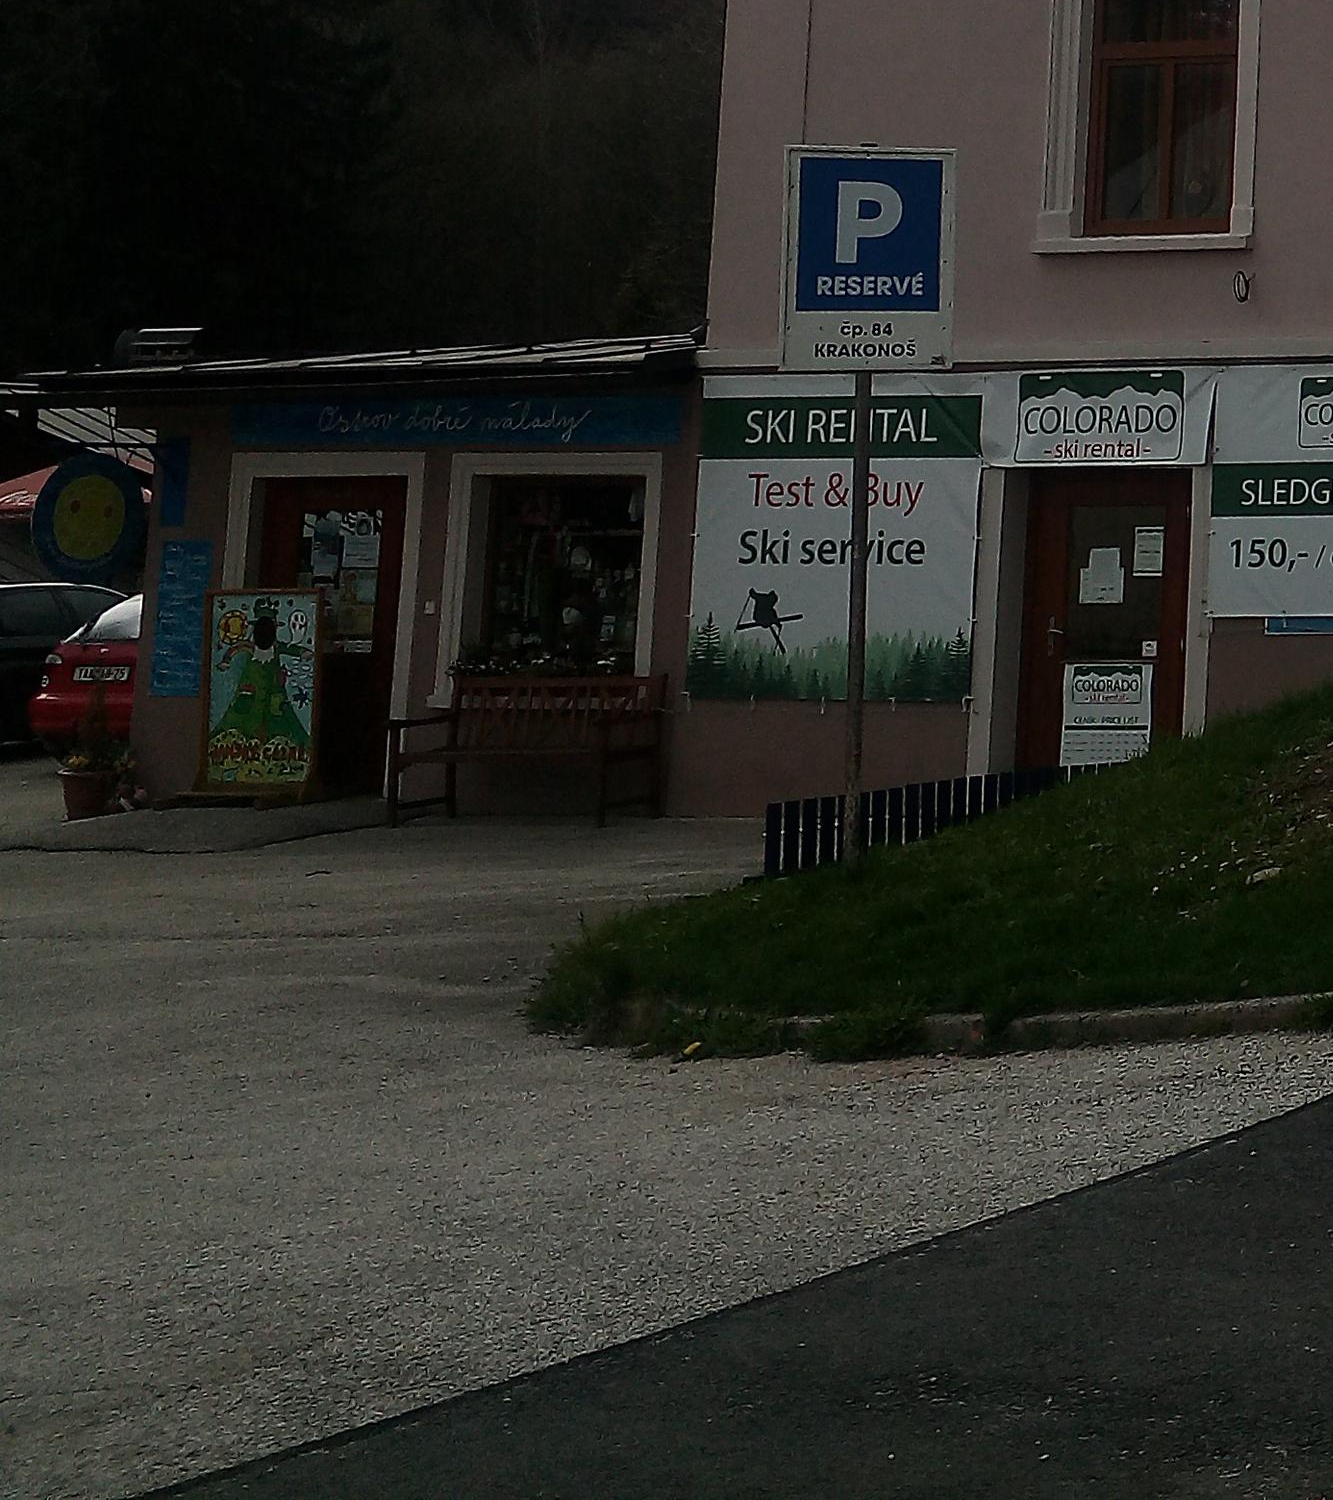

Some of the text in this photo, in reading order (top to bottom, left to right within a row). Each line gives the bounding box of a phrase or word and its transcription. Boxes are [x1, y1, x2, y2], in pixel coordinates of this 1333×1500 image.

[836, 181, 903, 263] P
[817, 272, 924, 296] RESERVÉ
[840, 321, 893, 338] čp. 84
[814, 339, 916, 358] KRAKONOŠ
[320, 401, 592, 442] Ostrov dobré nálady
[745, 409, 795, 444] SKI
[1024, 404, 1178, 434] COLORADO
[748, 473, 815, 508] Test
[824, 472, 850, 507] &
[738, 529, 791, 565] Ski
[1230, 538, 1309, 573] 150,-
[1314, 544, 1327, 569] /
[1074, 679, 1139, 693] COLORADO
